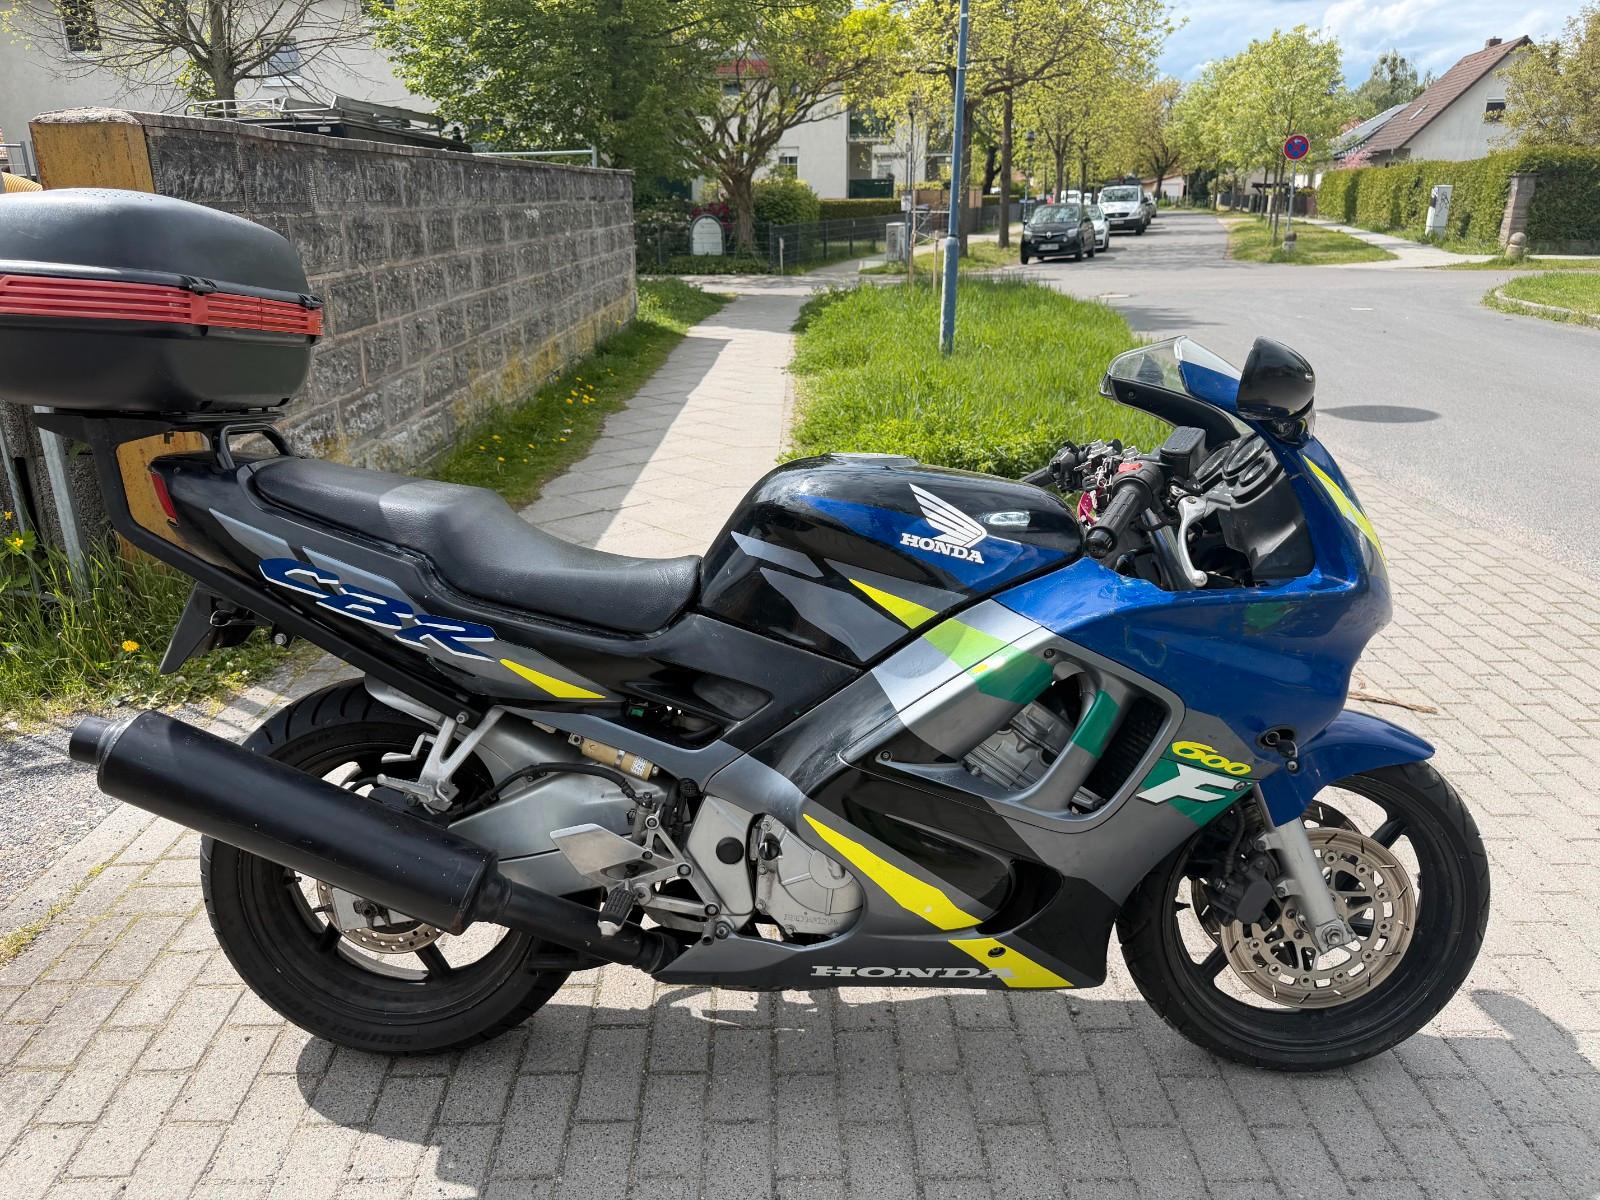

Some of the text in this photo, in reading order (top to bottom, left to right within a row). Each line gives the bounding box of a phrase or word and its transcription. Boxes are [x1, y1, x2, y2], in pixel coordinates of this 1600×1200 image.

[901, 532, 985, 564] HONDA
[258, 557, 497, 662] CBR
[1171, 740, 1252, 776] 600
[1135, 762, 1253, 804] F
[810, 964, 1016, 980] HONDA
